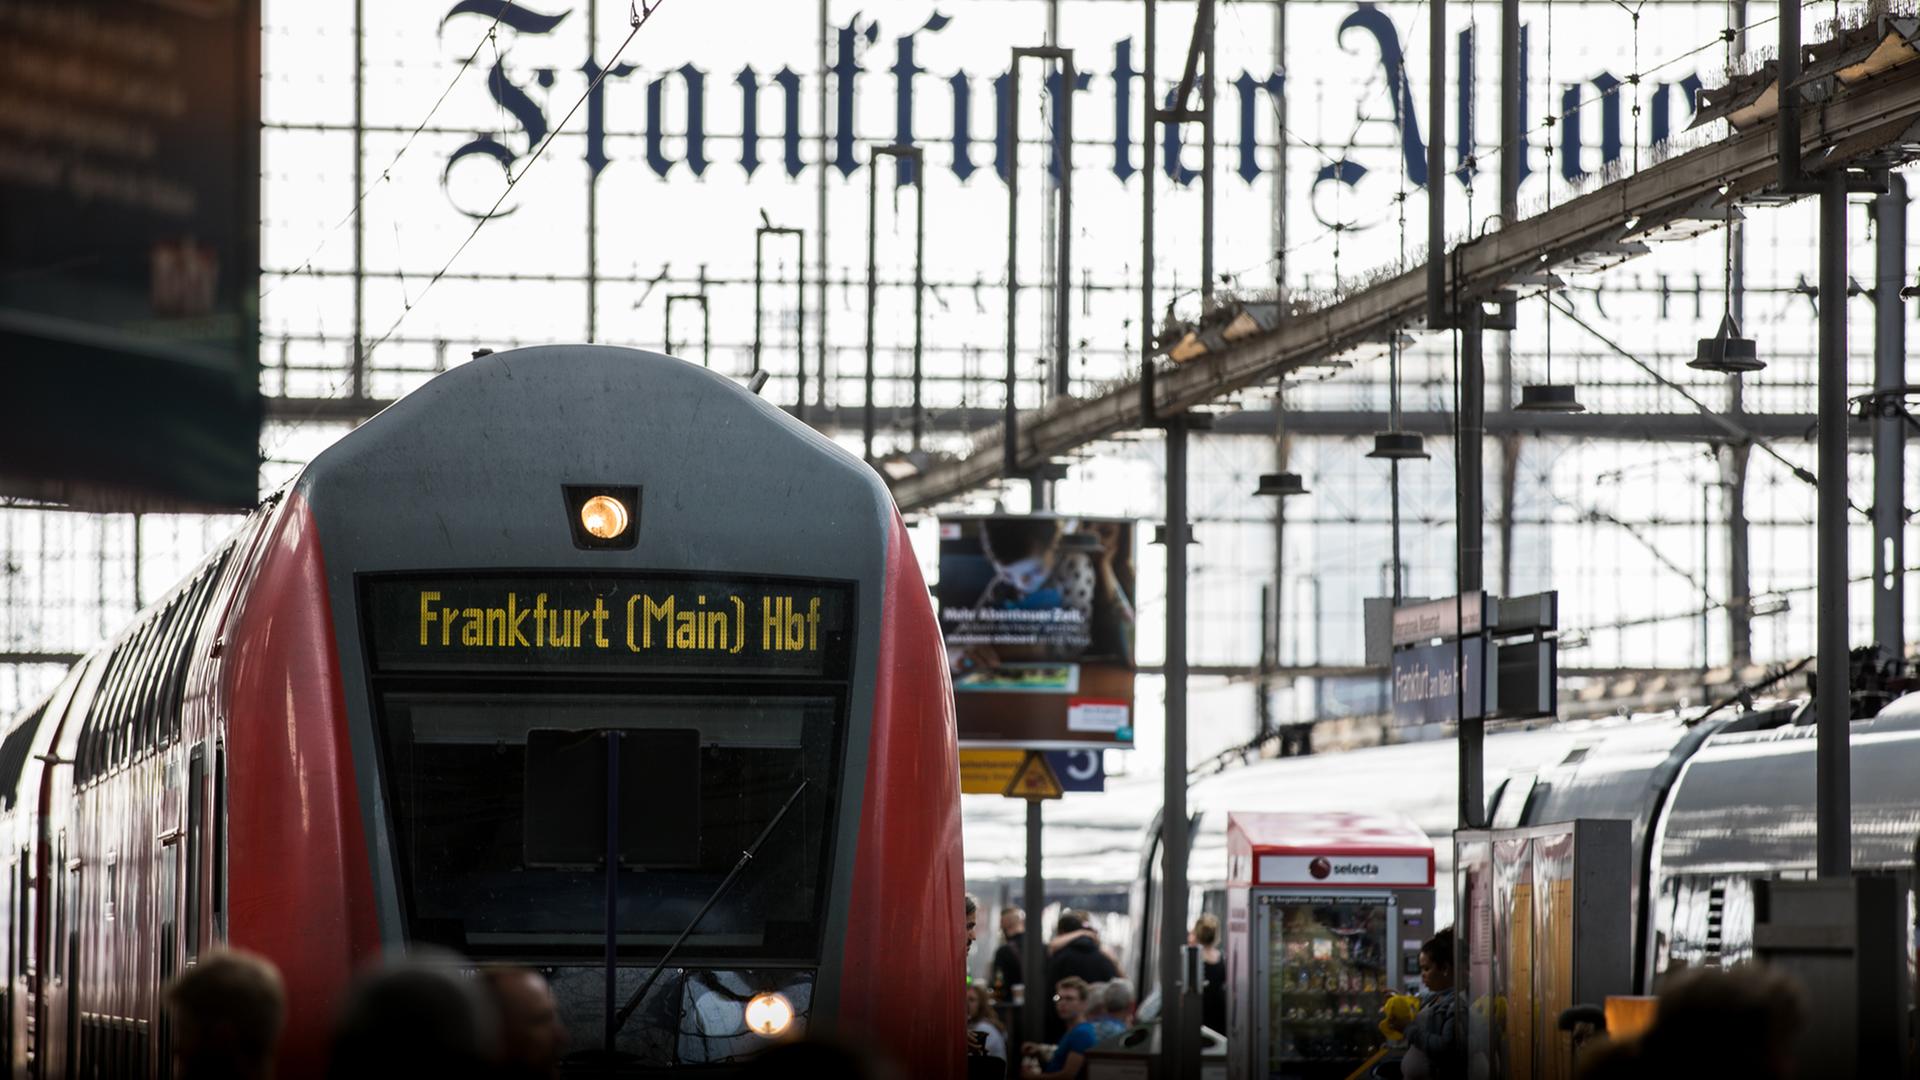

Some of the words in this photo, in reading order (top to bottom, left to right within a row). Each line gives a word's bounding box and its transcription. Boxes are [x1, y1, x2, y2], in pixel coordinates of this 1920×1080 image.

[420, 591, 609, 648] Frankfurt
[627, 594, 745, 654] (Main)
[763, 596, 821, 651] Hbf
[943, 607, 976, 621] Mehr
[978, 608, 1051, 622] Abenteuer
[1396, 663, 1428, 703] Frankfurt
[1333, 863, 1379, 875] selecta
